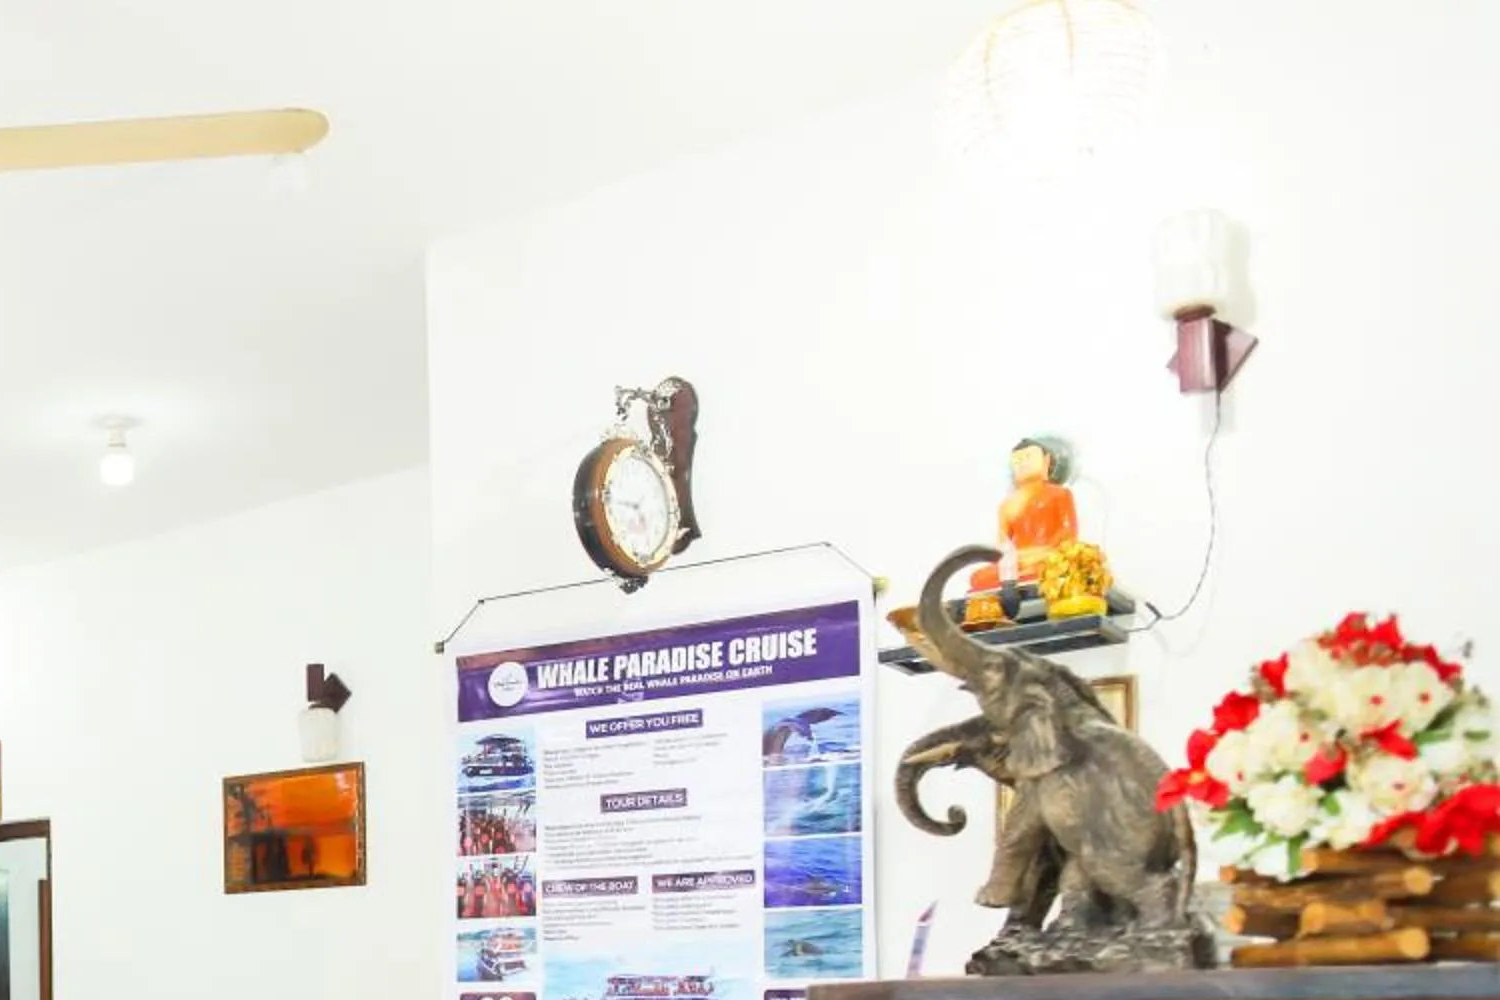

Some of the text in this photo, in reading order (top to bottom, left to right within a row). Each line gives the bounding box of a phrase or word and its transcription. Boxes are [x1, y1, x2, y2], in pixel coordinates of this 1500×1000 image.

[537, 628, 818, 689] WHALE PARADISE CRUISE
[605, 683, 621, 694] THE
[648, 676, 678, 689] WHALE
[742, 665, 773, 678] EARTH
[589, 713, 700, 734] WE OFFER YOU FREE
[605, 793, 684, 809] TOUR DETAILS
[589, 881, 607, 892] THE
[609, 880, 635, 891] BOAT
[656, 873, 754, 888] WE ARE APPROVED
